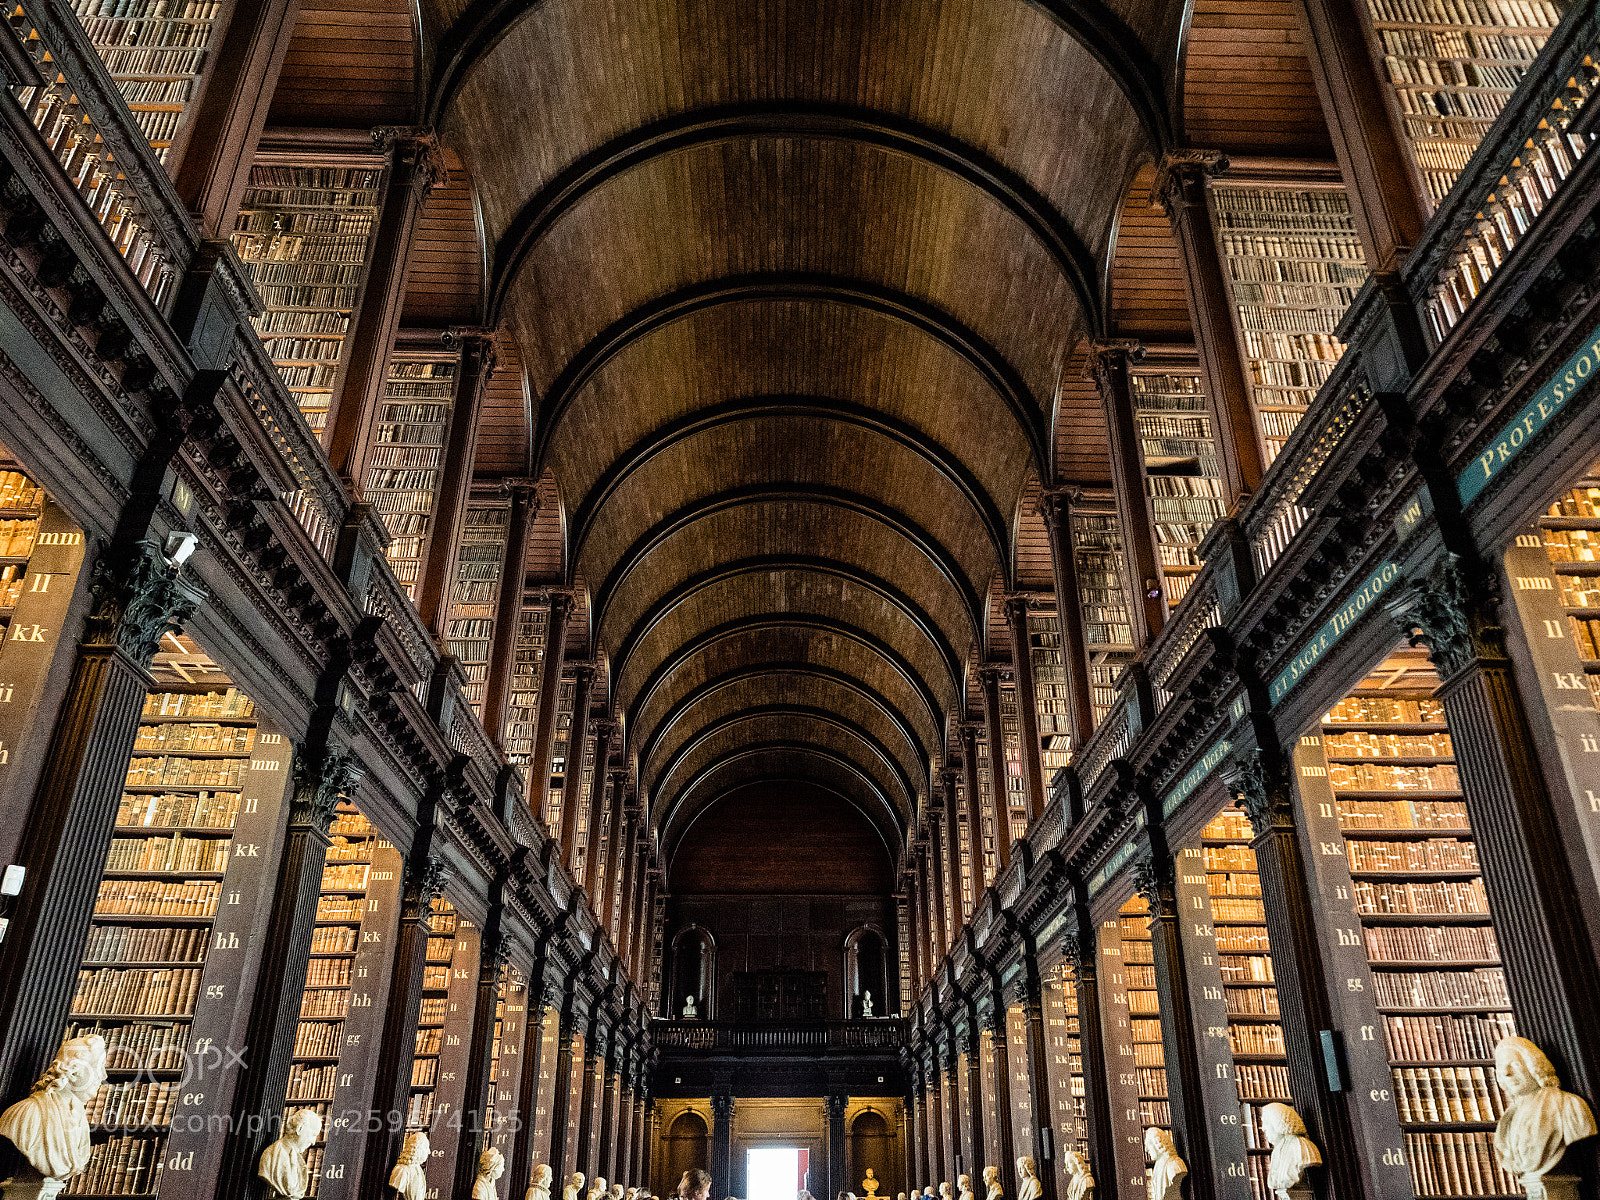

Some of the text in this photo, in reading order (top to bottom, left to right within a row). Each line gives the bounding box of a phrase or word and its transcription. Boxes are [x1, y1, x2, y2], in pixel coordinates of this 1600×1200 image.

[38, 531, 81, 546] mm
[1516, 534, 1542, 547] nn
[30, 573, 50, 593] ll
[1517, 576, 1553, 590] mm
[10, 624, 49, 642] kk
[1544, 620, 1565, 638] ll
[1553, 673, 1587, 689] kk
[260, 733, 281, 745] nn
[1301, 736, 1320, 745] nn
[1581, 734, 1598, 752] ii
[251, 759, 280, 771] mm
[1301, 766, 1327, 776] mm
[244, 799, 259, 813] ll
[1319, 803, 1333, 817] ll
[235, 844, 260, 857] kk
[1185, 849, 1201, 858] nn
[1320, 842, 1343, 855] kk
[371, 871, 393, 881] mm
[1183, 875, 1206, 884] mm
[227, 890, 241, 905] ii
[1336, 886, 1348, 899] ii
[367, 900, 378, 911] ll
[1193, 897, 1203, 909] ll
[1103, 920, 1117, 928] nn
[1195, 925, 1212, 936] kk
[215, 932, 240, 950] hh
[363, 931, 381, 943] kk
[1336, 929, 1361, 945] hh
[458, 942, 467, 951] ll
[1103, 948, 1121, 956] mm
[1203, 953, 1213, 966] ii
[357, 966, 368, 978] ii
[454, 969, 469, 979] kk
[1347, 979, 1363, 991] gg
[206, 984, 225, 999] gg
[1204, 987, 1222, 1000] hh
[352, 993, 372, 1007] hh
[1114, 994, 1127, 1004] kk
[1208, 1026, 1224, 1038] gg
[1361, 1025, 1375, 1040] ff
[346, 1034, 361, 1045] gg
[446, 1035, 460, 1046] hh
[194, 1038, 212, 1055] ff
[503, 1045, 517, 1054] kk
[1120, 1045, 1133, 1056] hh
[1055, 1055, 1067, 1064] kk
[441, 1072, 456, 1081] gg
[1216, 1064, 1228, 1079] ff
[339, 1073, 354, 1087] ff
[1120, 1074, 1135, 1086] gg
[183, 1091, 204, 1106] ee
[1370, 1089, 1389, 1101] ee
[1059, 1100, 1071, 1110] hh
[333, 1115, 349, 1128] ee
[1220, 1114, 1237, 1125] ee
[1128, 1135, 1140, 1144] ee
[432, 1150, 445, 1158] ee
[1382, 1148, 1405, 1165] dd
[169, 1151, 193, 1171] dd
[326, 1165, 344, 1179] dd
[1228, 1163, 1246, 1177] dd
[1131, 1175, 1144, 1186] dd
